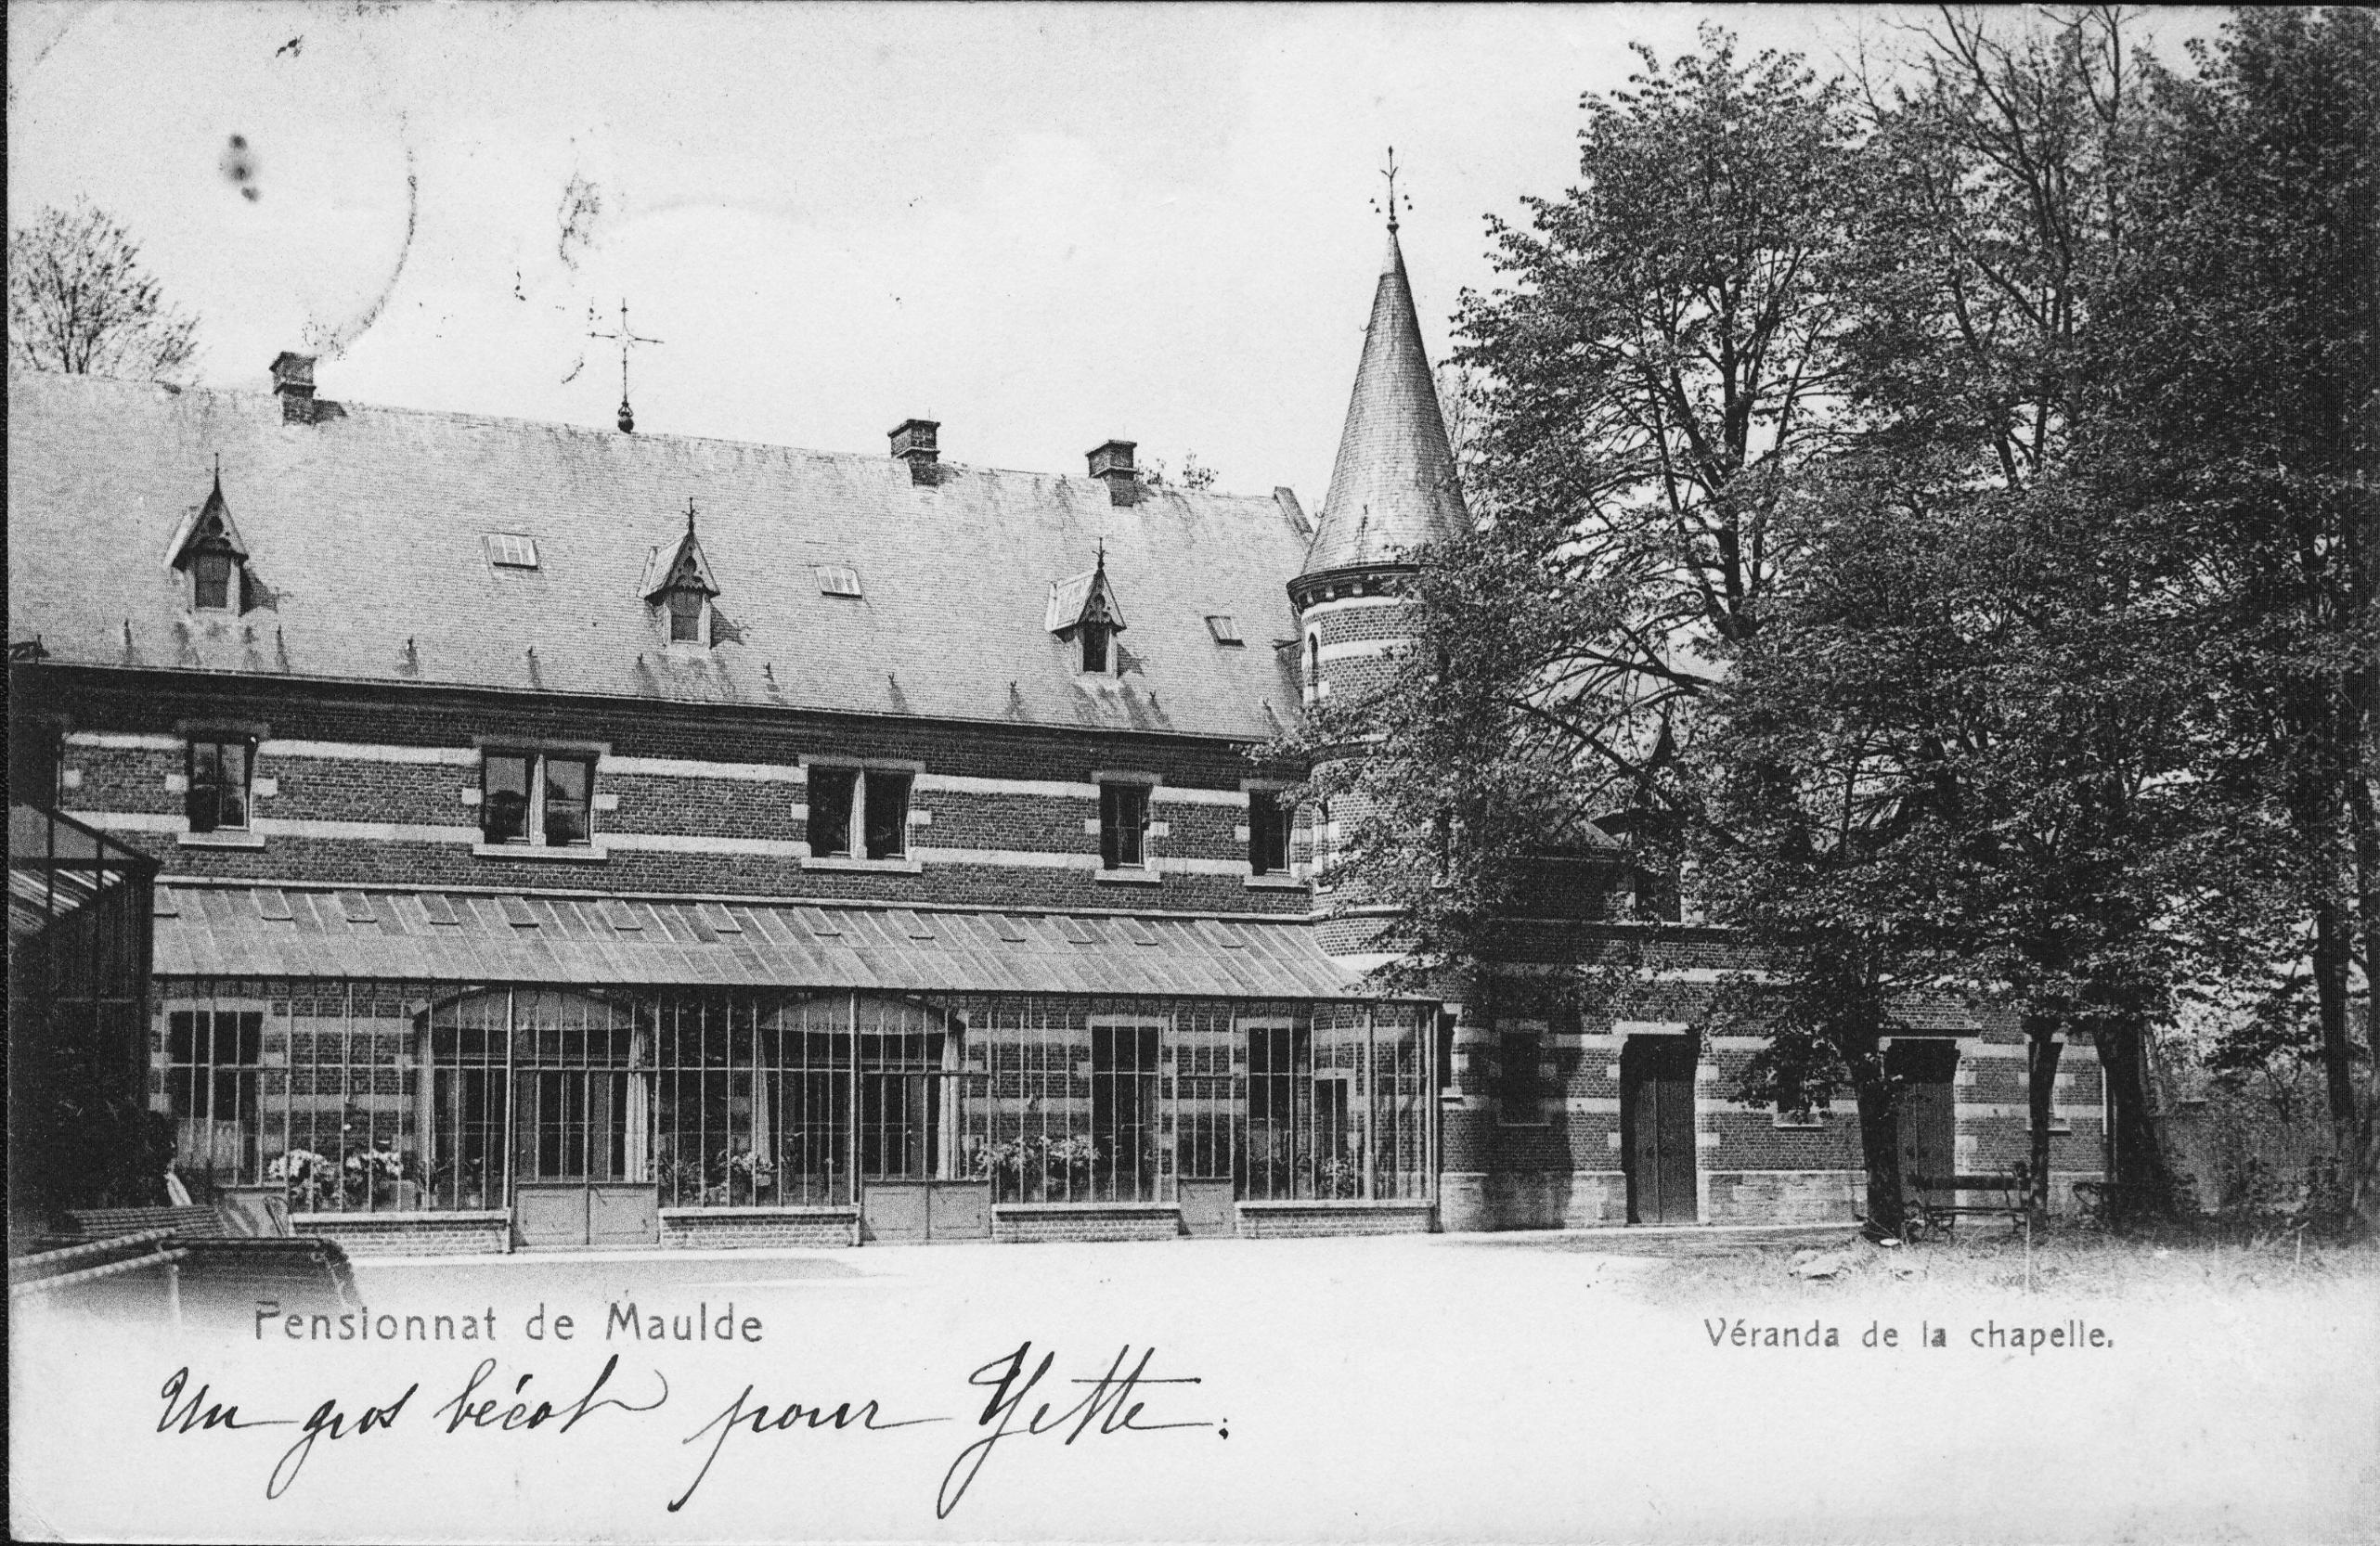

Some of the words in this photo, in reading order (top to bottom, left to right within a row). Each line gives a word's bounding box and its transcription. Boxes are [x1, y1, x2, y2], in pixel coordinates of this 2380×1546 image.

[155, 1365, 278, 1434] Un
[265, 1382, 420, 1500] gros
[666, 1384, 952, 1512] pour
